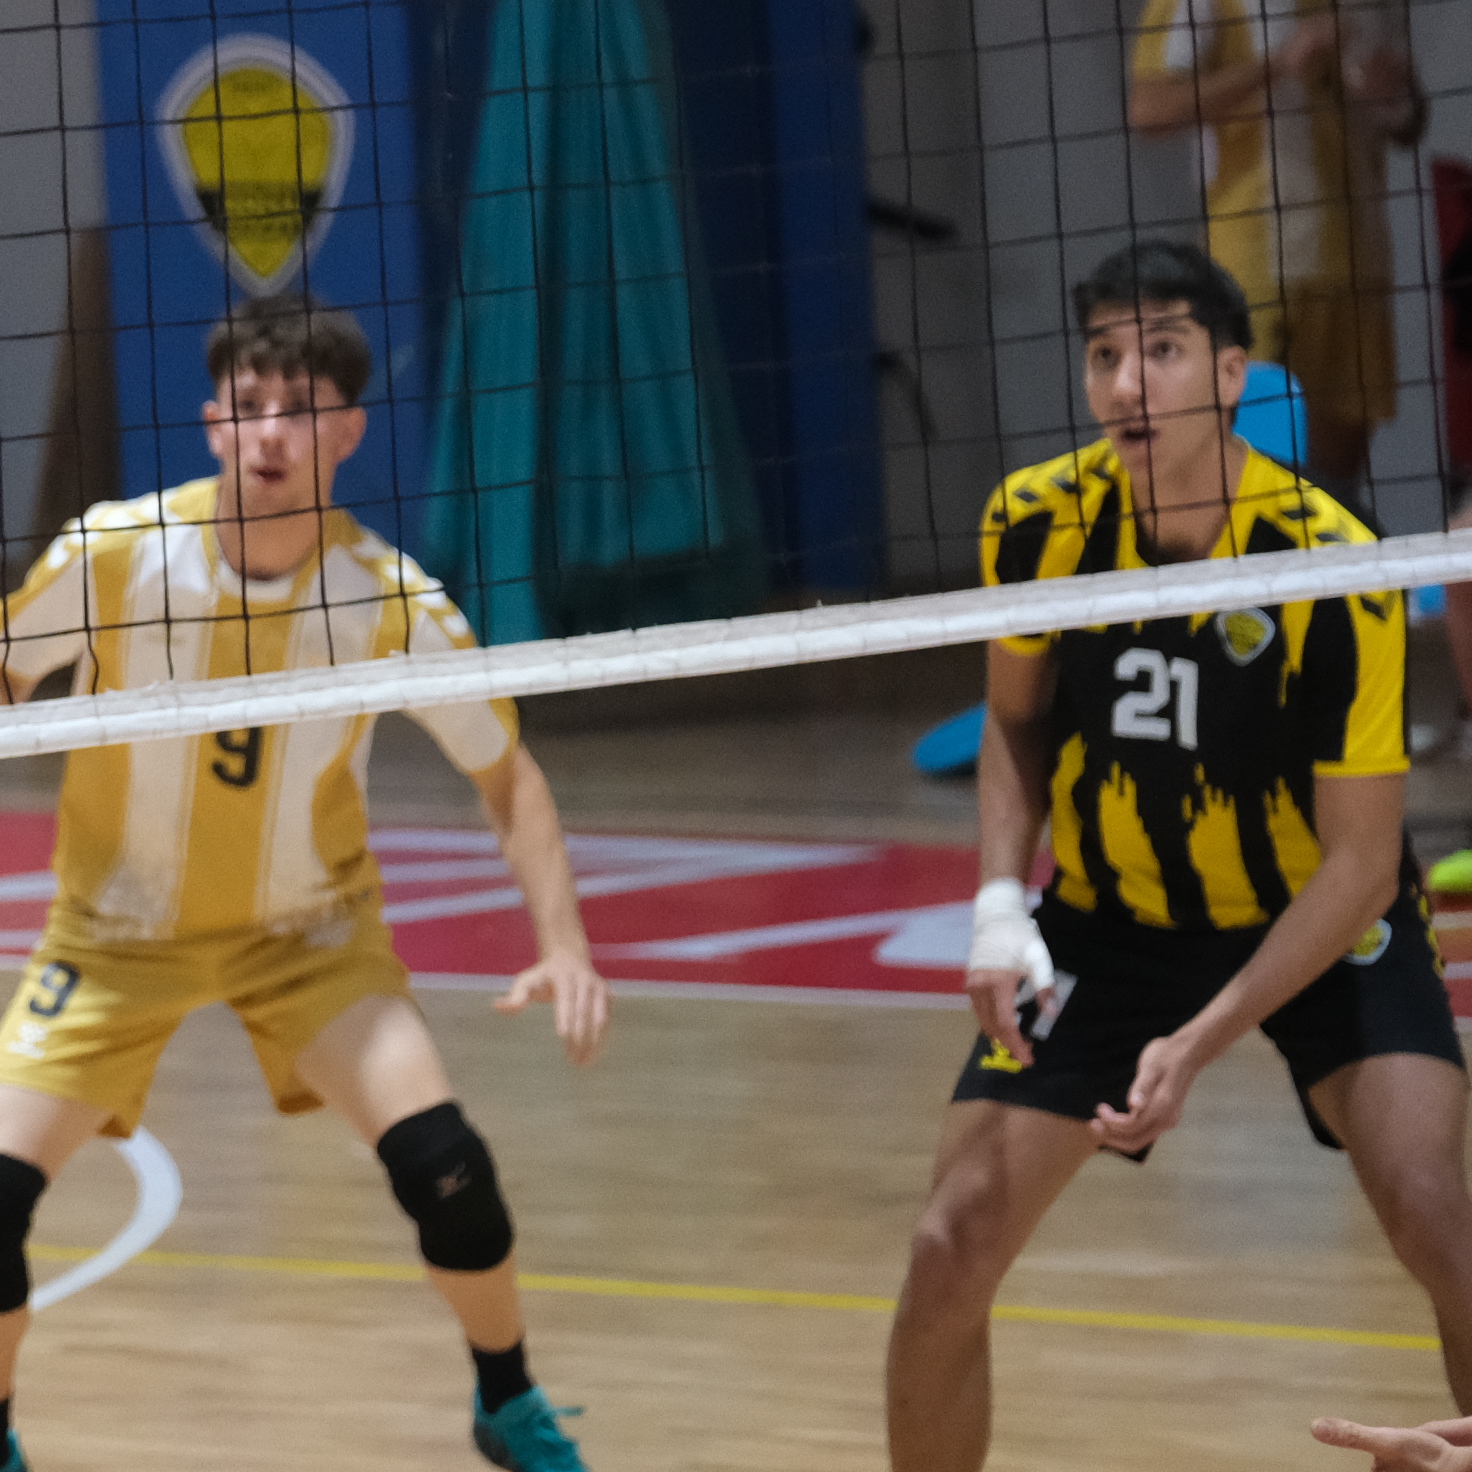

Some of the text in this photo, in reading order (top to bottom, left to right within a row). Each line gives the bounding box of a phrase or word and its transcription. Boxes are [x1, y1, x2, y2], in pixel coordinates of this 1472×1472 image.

[1111, 647, 1199, 751] 21
[211, 726, 263, 789] 9
[28, 959, 80, 1021] 9
